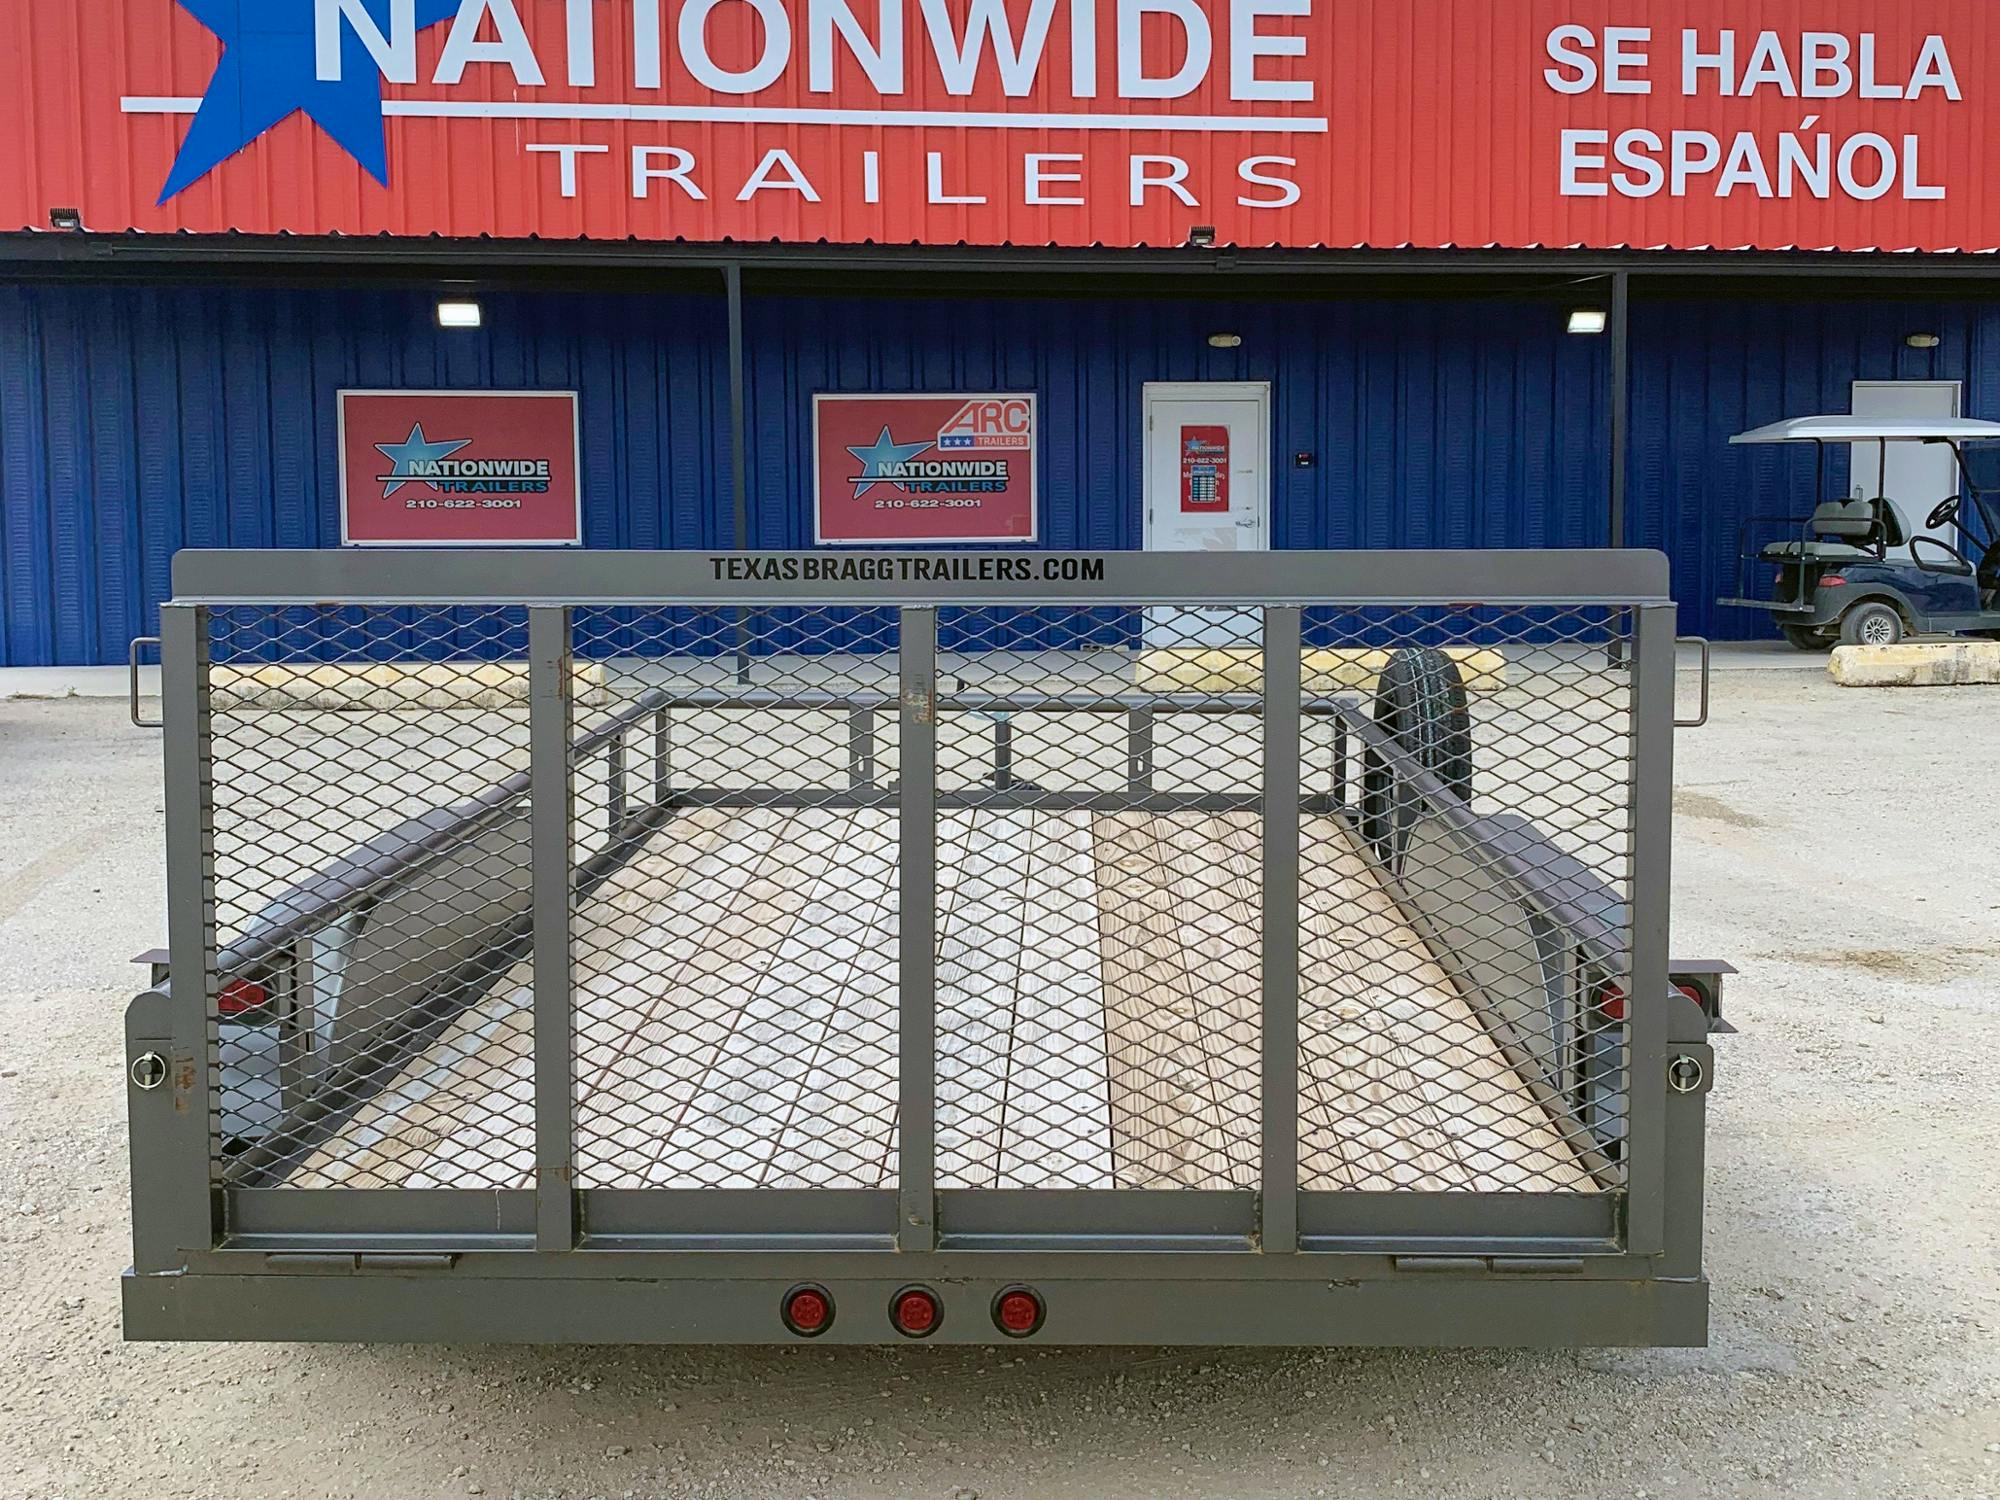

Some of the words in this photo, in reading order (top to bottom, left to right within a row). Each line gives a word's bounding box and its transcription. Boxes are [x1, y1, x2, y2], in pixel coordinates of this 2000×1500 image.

[315, 0, 1315, 102] NATIONWIDE
[1543, 24, 1652, 95] SE
[1682, 28, 1963, 101] HABLA
[525, 143, 1302, 208] TRAILERS
[942, 401, 1029, 433] ARC
[978, 437, 1025, 446] TRAILERS
[408, 460, 549, 477] NATIONWIDE
[877, 461, 1008, 477] NATIONWIDE
[439, 481, 548, 492] TRAILERS
[907, 481, 1007, 492] TRAILERS
[405, 499, 522, 509] 210-622-3001
[874, 499, 982, 508] 210-622-3001
[710, 558, 1105, 581] TEXASBRAGGTRAILERS.COM
